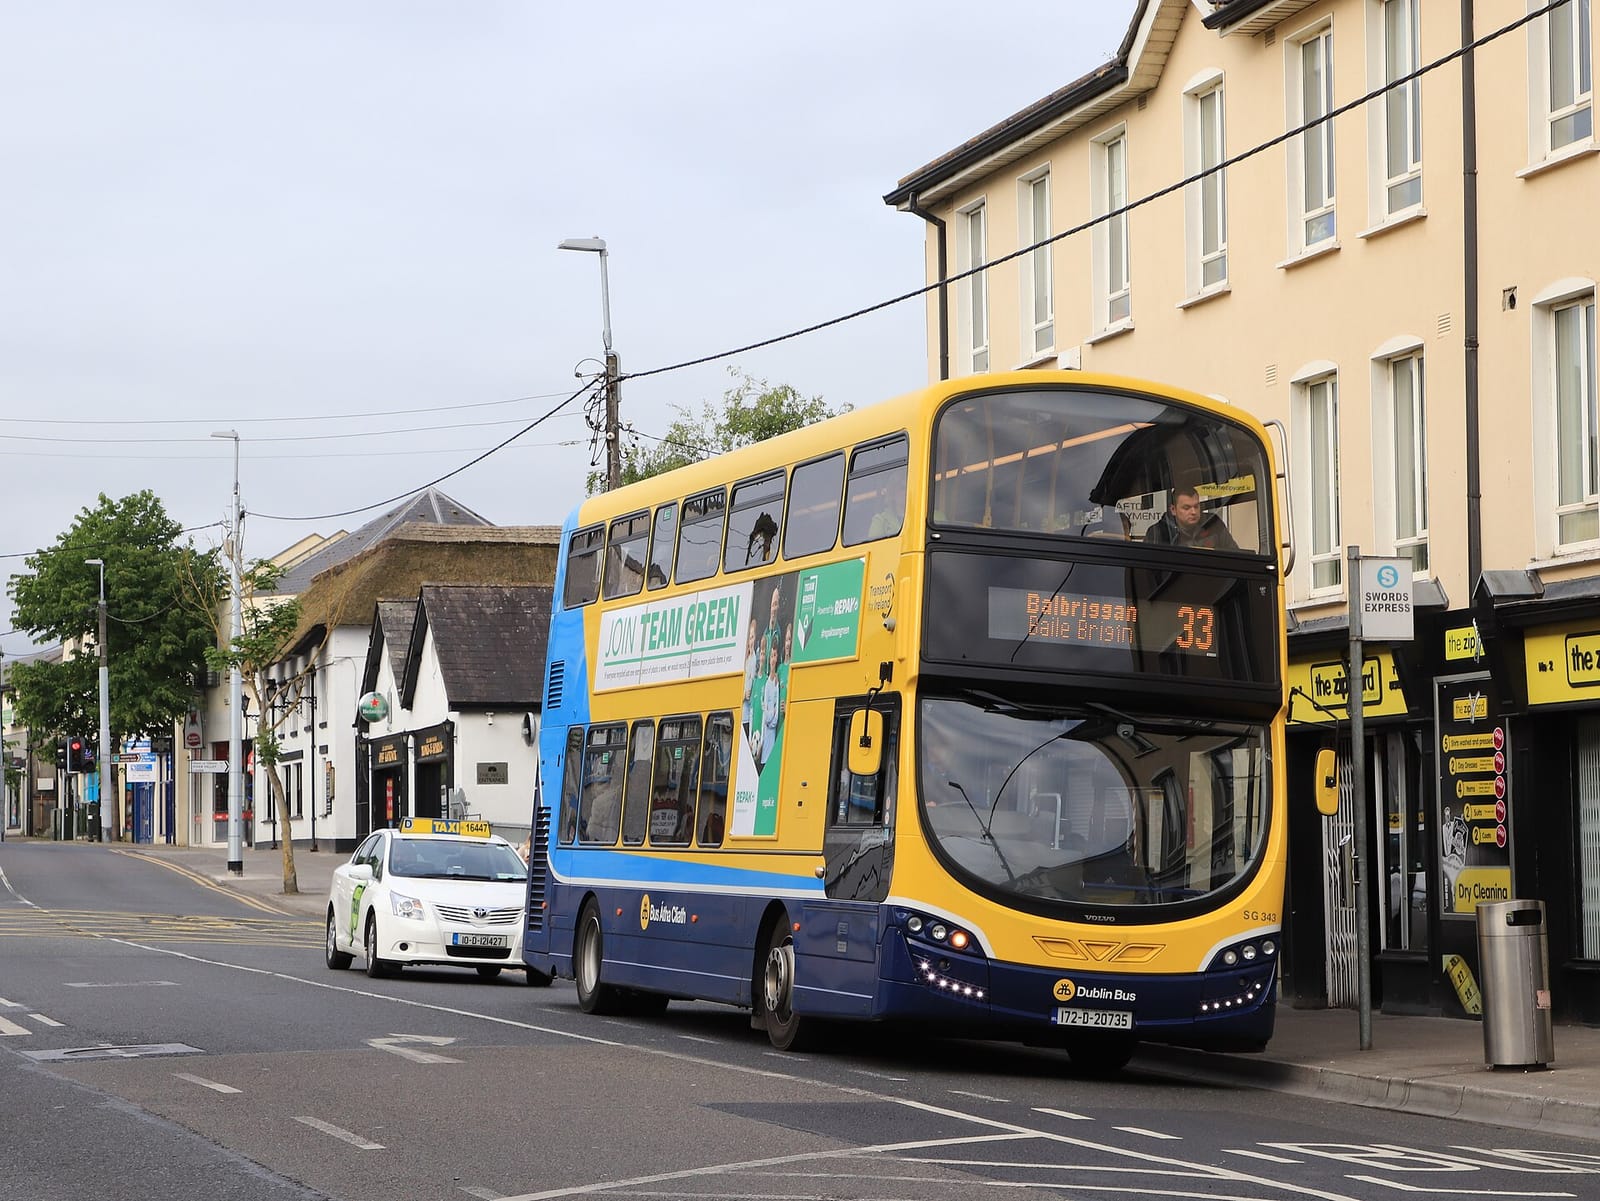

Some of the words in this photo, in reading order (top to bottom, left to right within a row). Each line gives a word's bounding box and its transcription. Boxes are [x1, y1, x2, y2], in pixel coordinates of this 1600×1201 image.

[1365, 591, 1409, 603] SWORDS
[834, 598, 856, 616] REPAK
[1026, 592, 1138, 623] Balbriggan
[1364, 603, 1411, 614] EXPRESS
[604, 616, 638, 657] JOIN
[640, 604, 681, 650] TEAM
[685, 595, 741, 645] GREEN
[1028, 614, 1071, 639] Baile
[1176, 605, 1215, 650] 33
[1448, 635, 1462, 652] the
[1571, 644, 1594, 672] the
[1315, 673, 1331, 697] the
[1333, 666, 1375, 700] ziprd
[404, 819, 412, 828] D
[433, 821, 460, 832] TAXI
[465, 823, 488, 832] 16447
[1458, 883, 1472, 904] Dry
[1473, 883, 1508, 900] Cleaning
[650, 904, 660, 922] Bus
[1084, 914, 1115, 922] VOLVO
[1260, 911, 1277, 923] 343
[461, 935, 503, 946] 10-D-121427
[1076, 985, 1113, 1000] Dublin
[1113, 989, 1137, 1002] Bus
[1060, 1008, 1129, 1028] 172-D-20735
